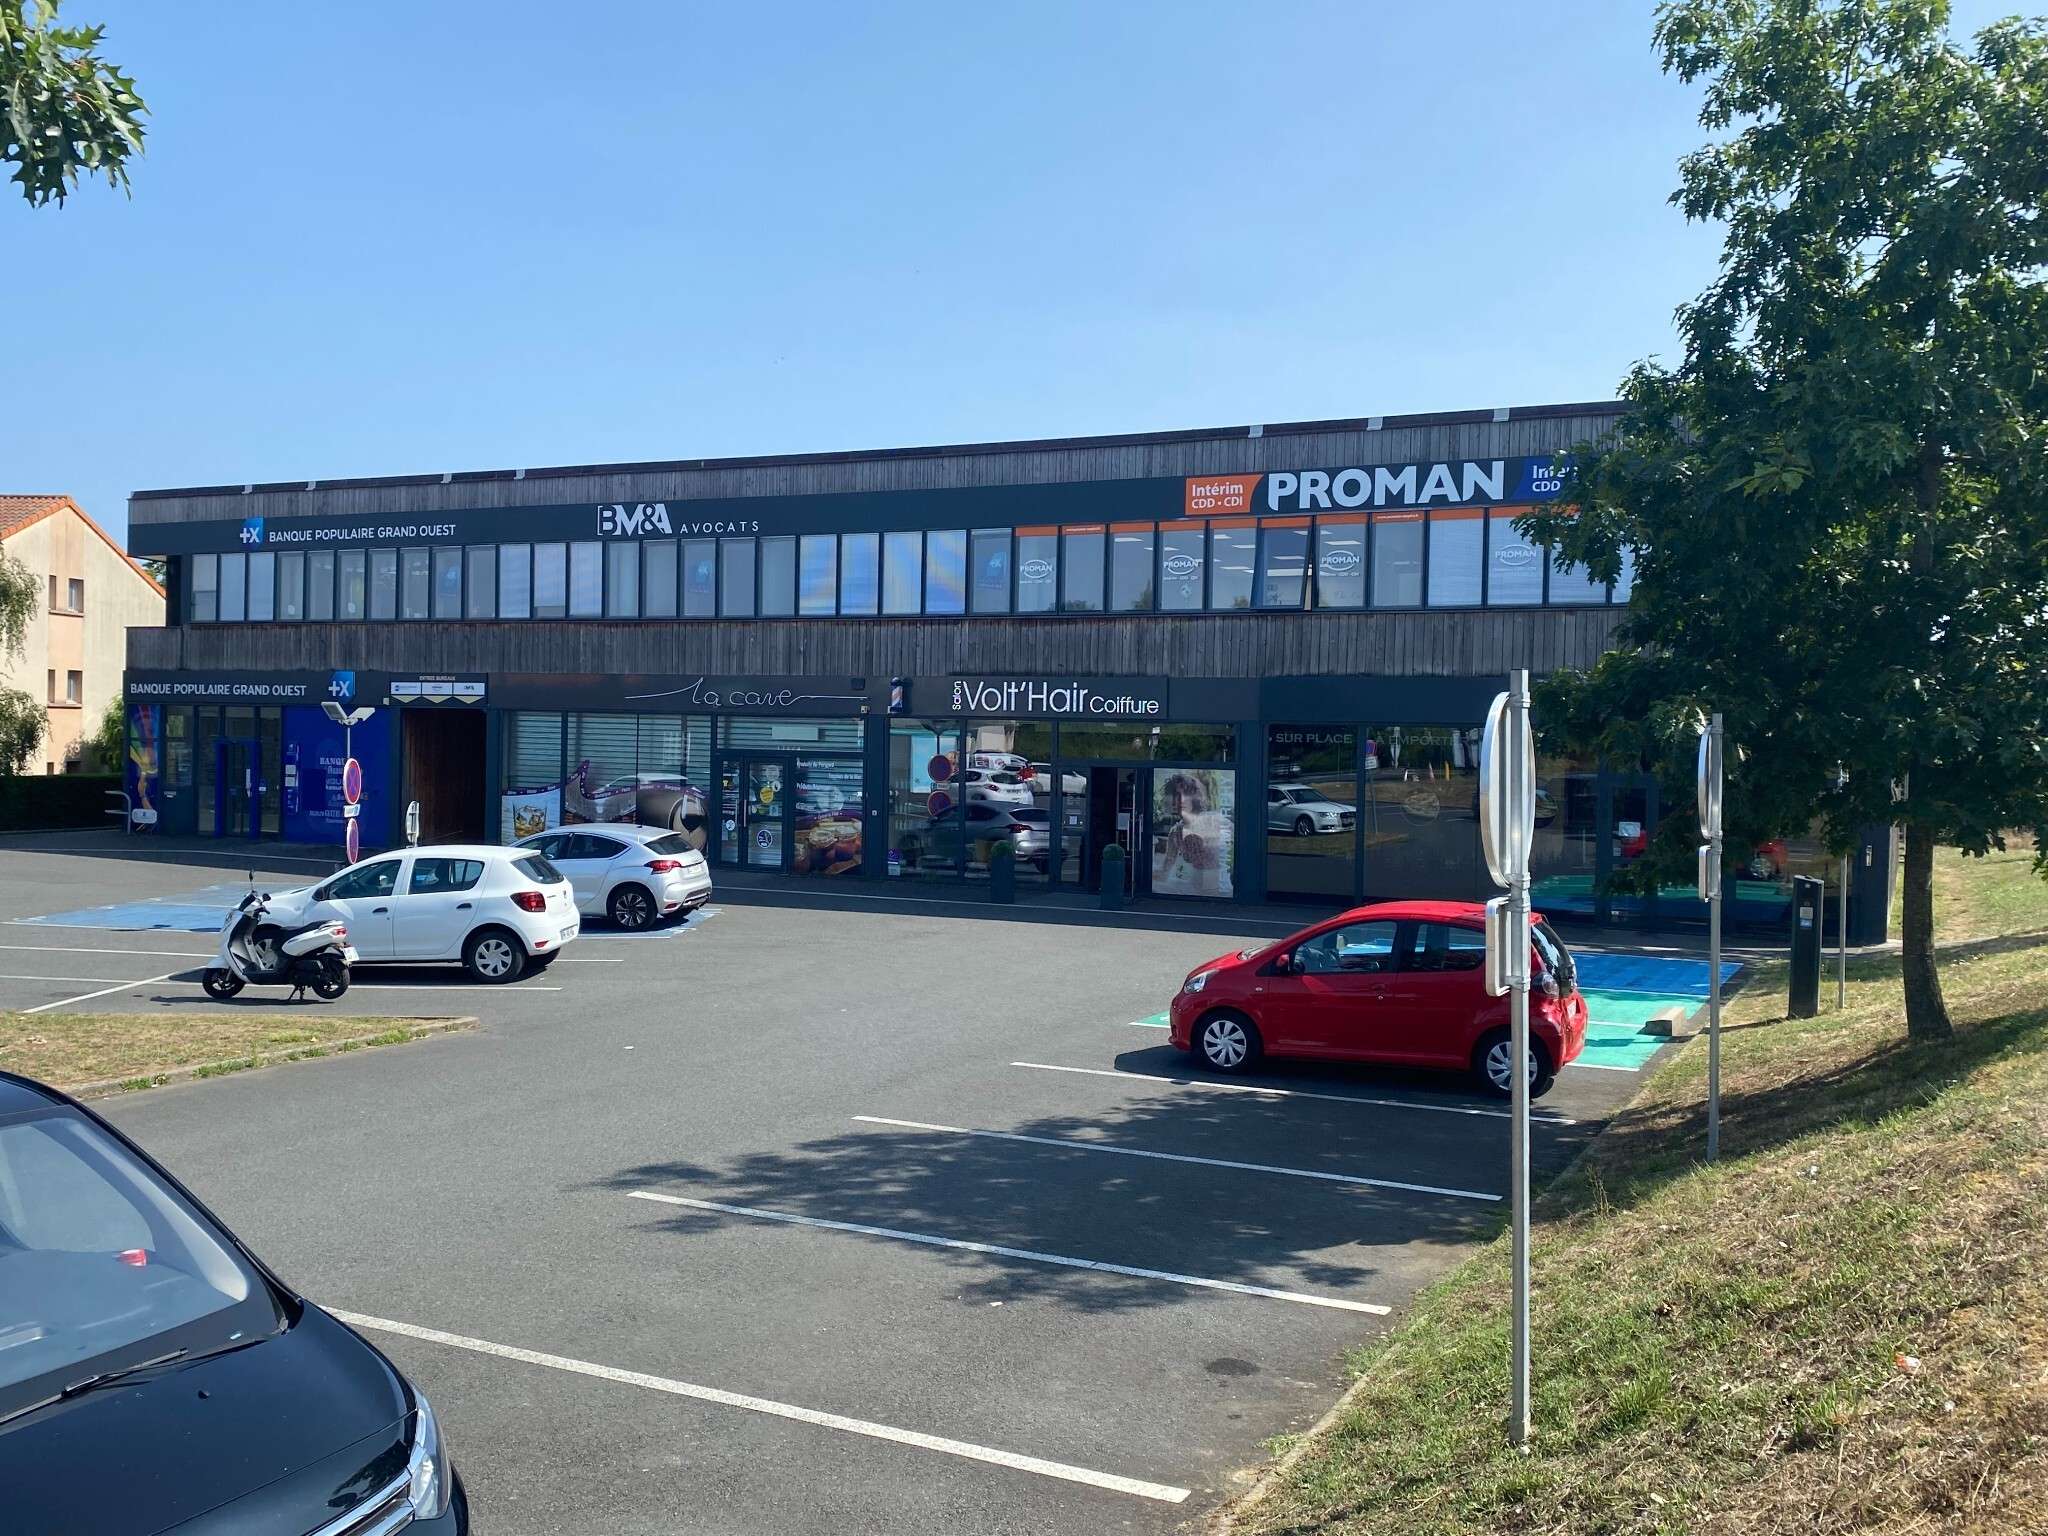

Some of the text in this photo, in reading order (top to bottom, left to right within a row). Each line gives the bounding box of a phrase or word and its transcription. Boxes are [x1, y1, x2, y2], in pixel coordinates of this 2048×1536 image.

[1192, 481, 1244, 497] Intérim
[1268, 460, 1505, 511] PROMAN
[1531, 480, 1561, 492] CDD
[1191, 496, 1243, 509] CDD CDI
[268, 529, 313, 542] BANQUE
[315, 527, 375, 541] POPULAIRE
[377, 525, 417, 538] GRAND
[419, 524, 457, 537] OUEST
[679, 520, 760, 534] AVOCATS
[130, 683, 171, 695] BANQUE
[173, 683, 230, 695] POPULAIRE
[233, 684, 270, 696] GRAND
[272, 685, 307, 697] OUEST
[952, 680, 962, 711] Salon
[1089, 696, 1160, 714] Coiffure
[1275, 733, 1353, 745] SUR PLACE
